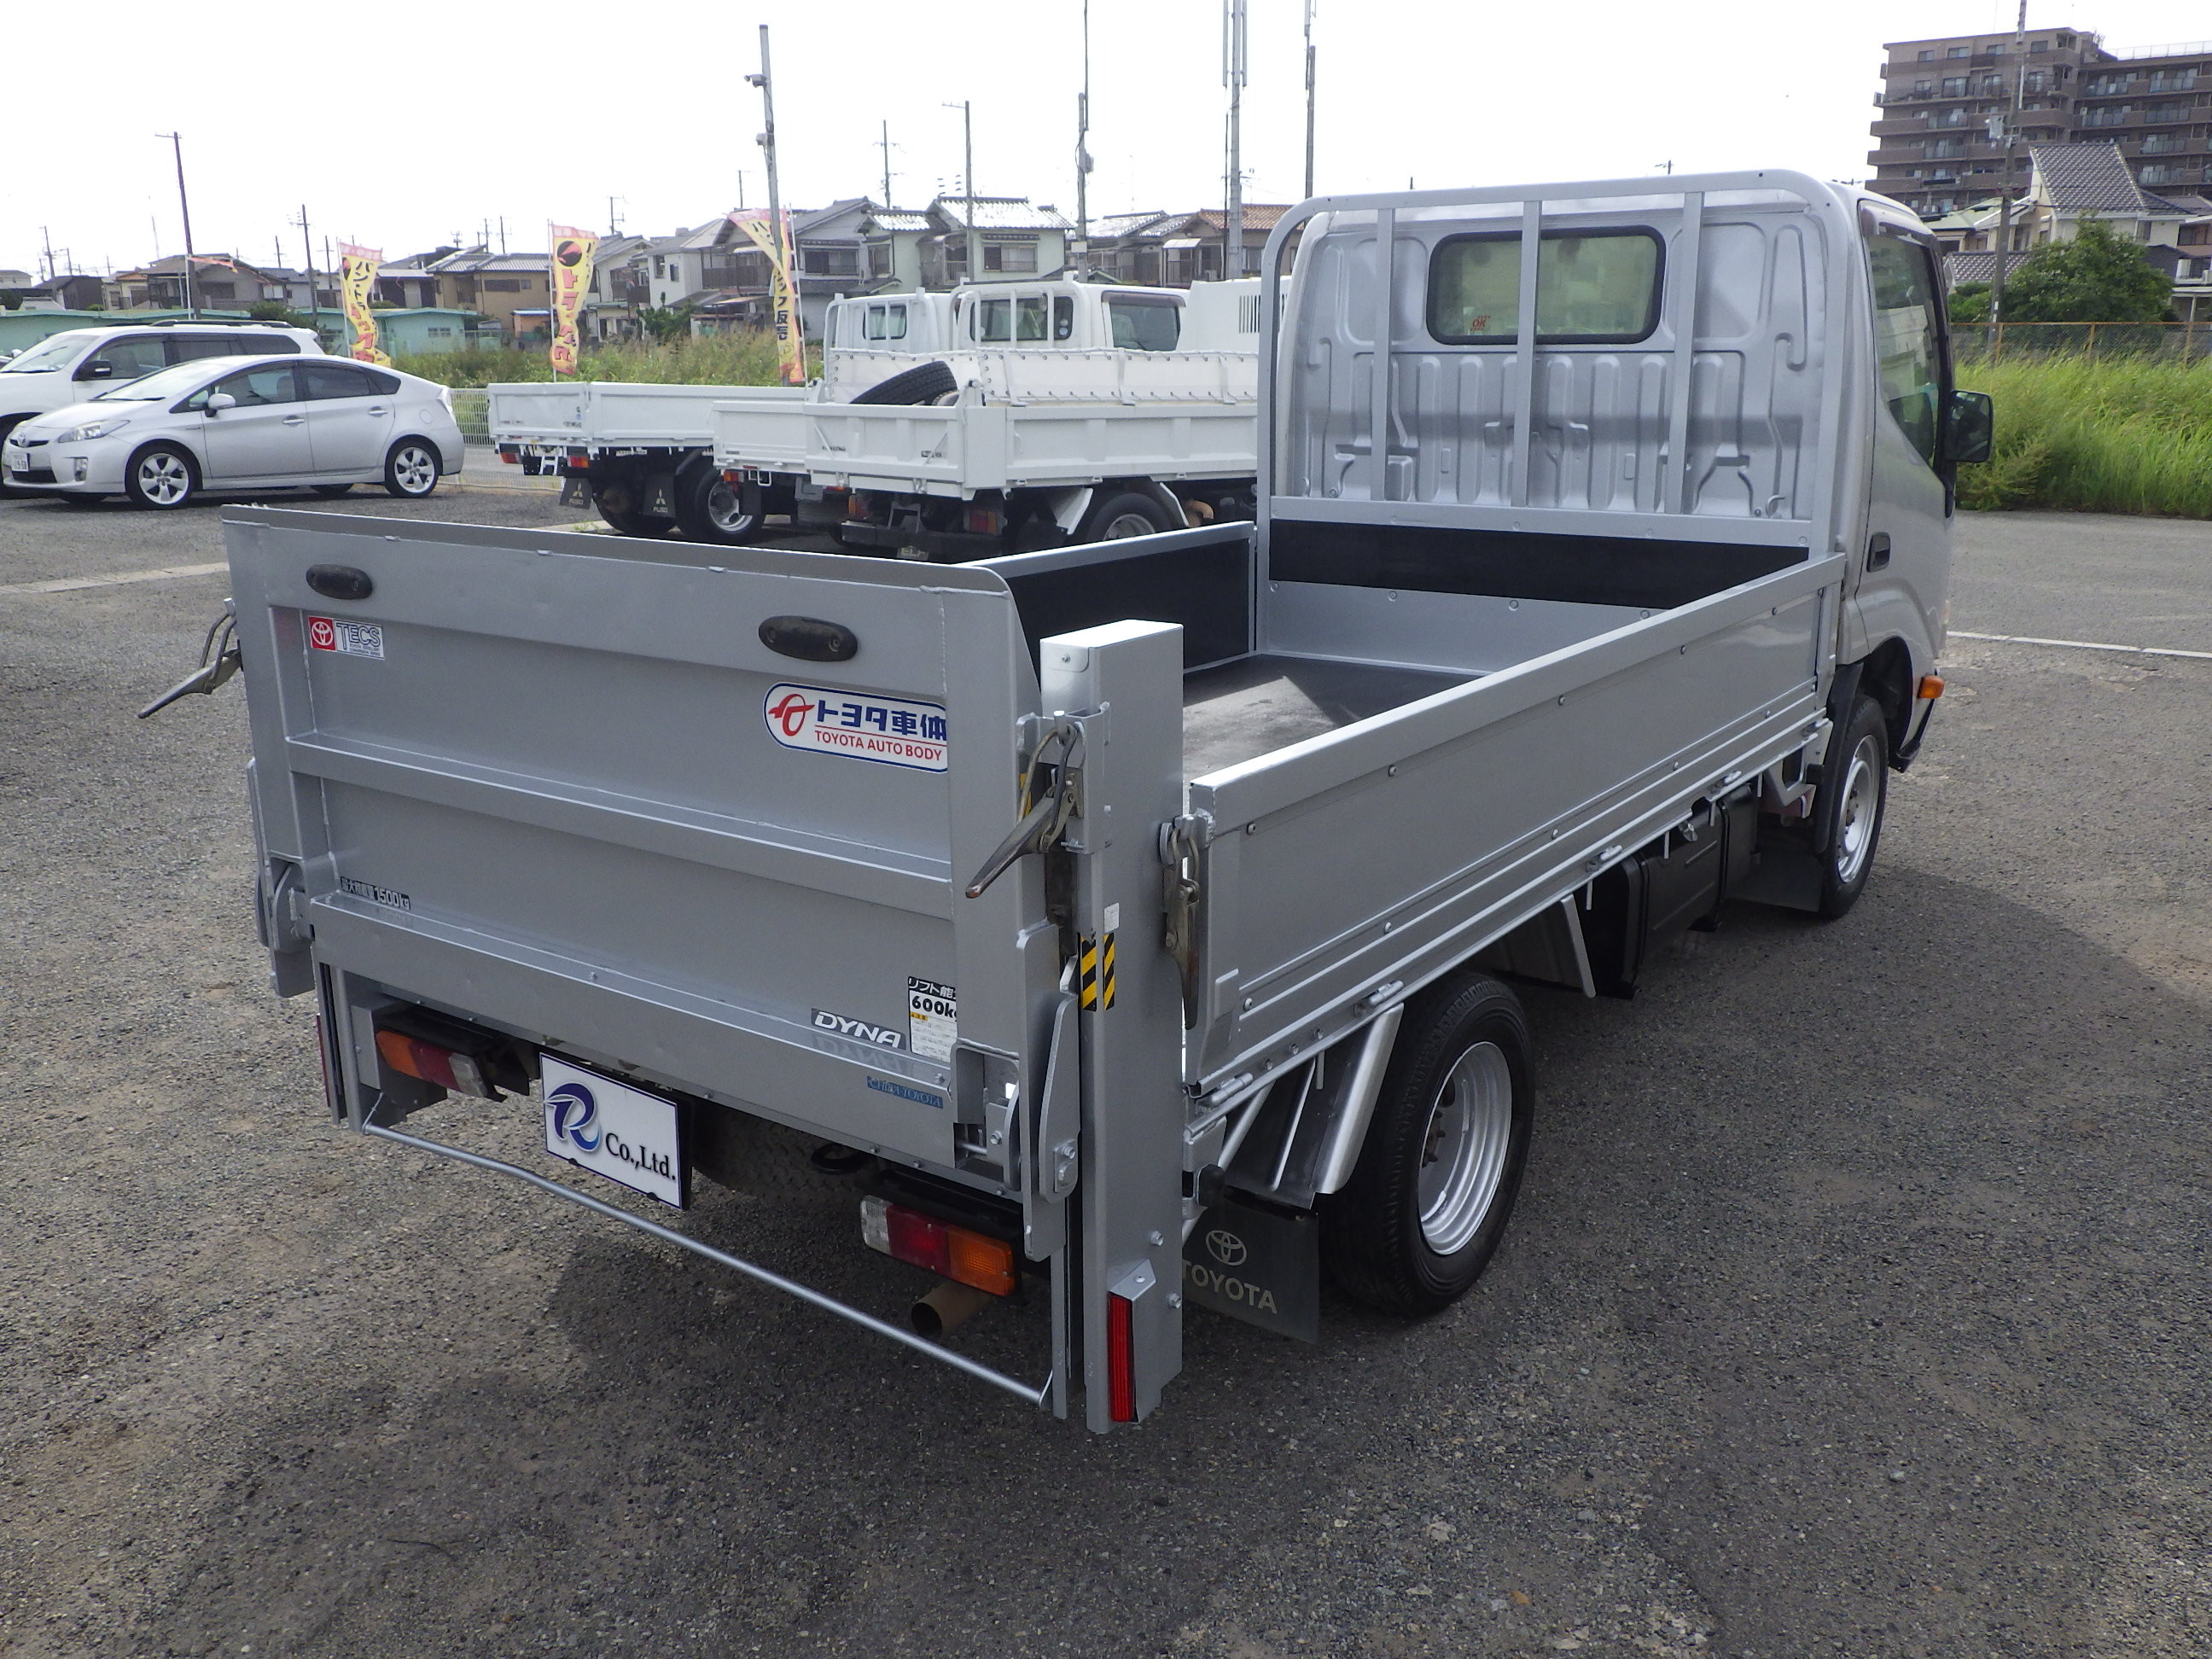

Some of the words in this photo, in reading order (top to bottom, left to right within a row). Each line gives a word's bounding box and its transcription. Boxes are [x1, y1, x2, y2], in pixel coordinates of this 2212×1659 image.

[336, 623, 381, 650] TECS
[817, 700, 946, 741] トヨタ車体
[815, 731, 864, 748] TOYOTA
[867, 739, 902, 754] AUTO
[905, 745, 942, 761] BODY
[909, 977, 956, 999] リフト能
[911, 996, 957, 1022] 600k
[815, 1011, 901, 1048] DYNA
[605, 1132, 676, 1181] Co.,Ltd.
[1182, 1259, 1278, 1314] TOYOTA
